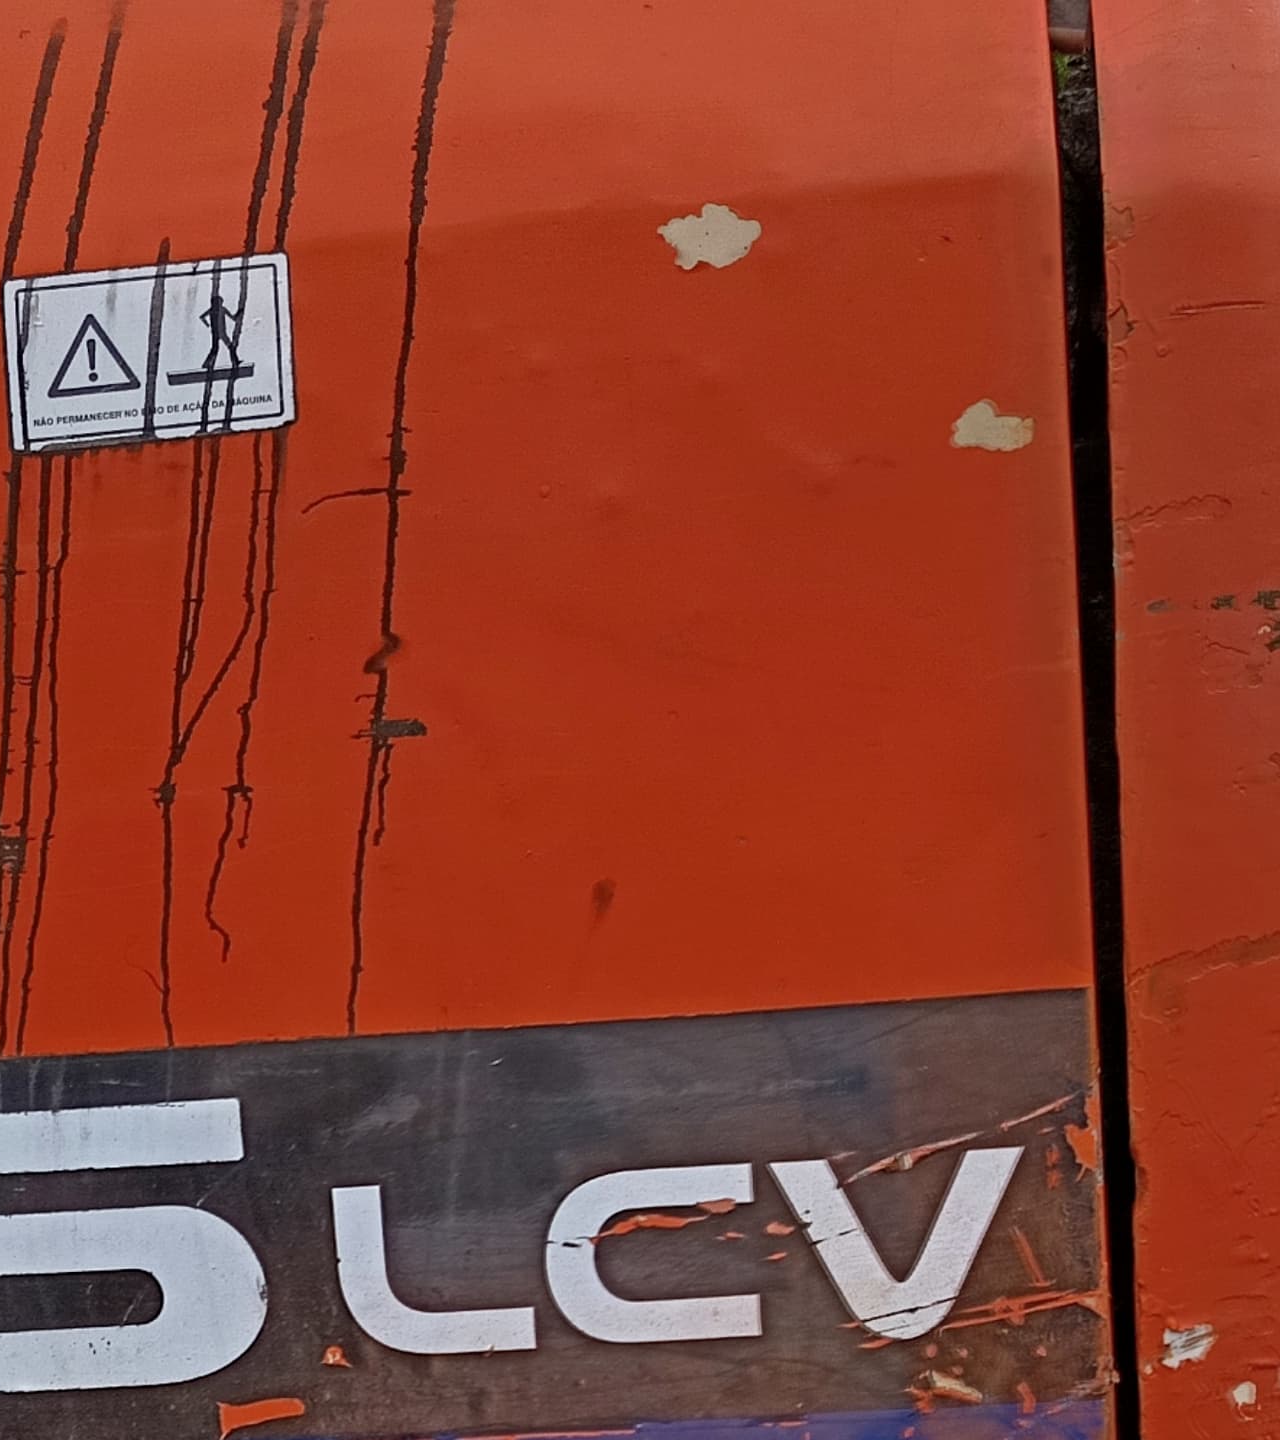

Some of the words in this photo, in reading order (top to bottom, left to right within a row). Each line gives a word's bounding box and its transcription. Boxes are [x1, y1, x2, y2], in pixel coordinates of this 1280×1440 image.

[33, 416, 54, 427] NÃO
[56, 410, 122, 425] PERMANECER
[124, 409, 138, 417] NO
[167, 404, 180, 414] DE
[183, 401, 209, 413] AÇÃ
[211, 400, 225, 409] DA
[331, 1146, 1025, 1354] LCV
